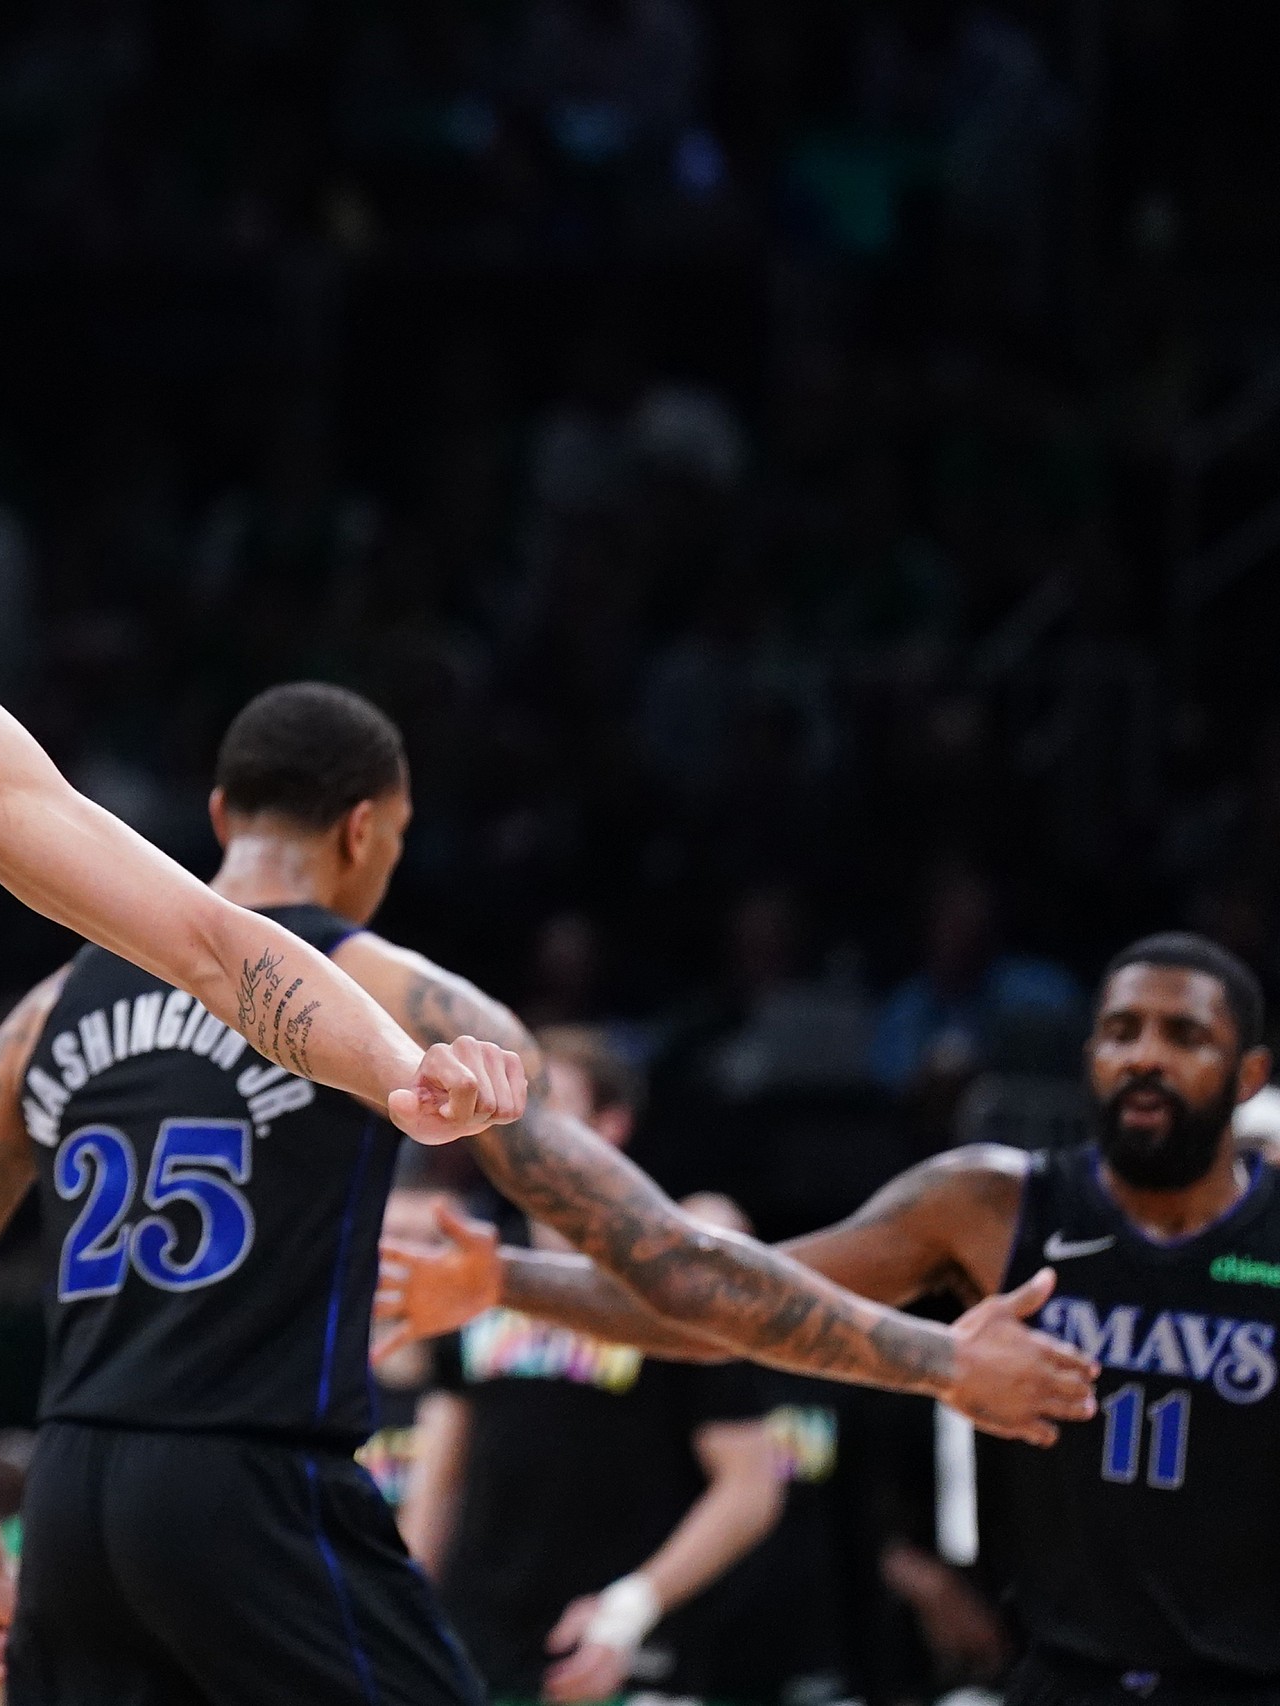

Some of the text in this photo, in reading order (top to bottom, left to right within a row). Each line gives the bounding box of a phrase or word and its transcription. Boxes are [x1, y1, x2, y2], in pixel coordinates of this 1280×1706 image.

[236, 1063, 317, 1139] JR.
[54, 1116, 256, 1304] 25
[1038, 1295, 1278, 1405] MAVS
[1100, 1382, 1192, 1491] 11
